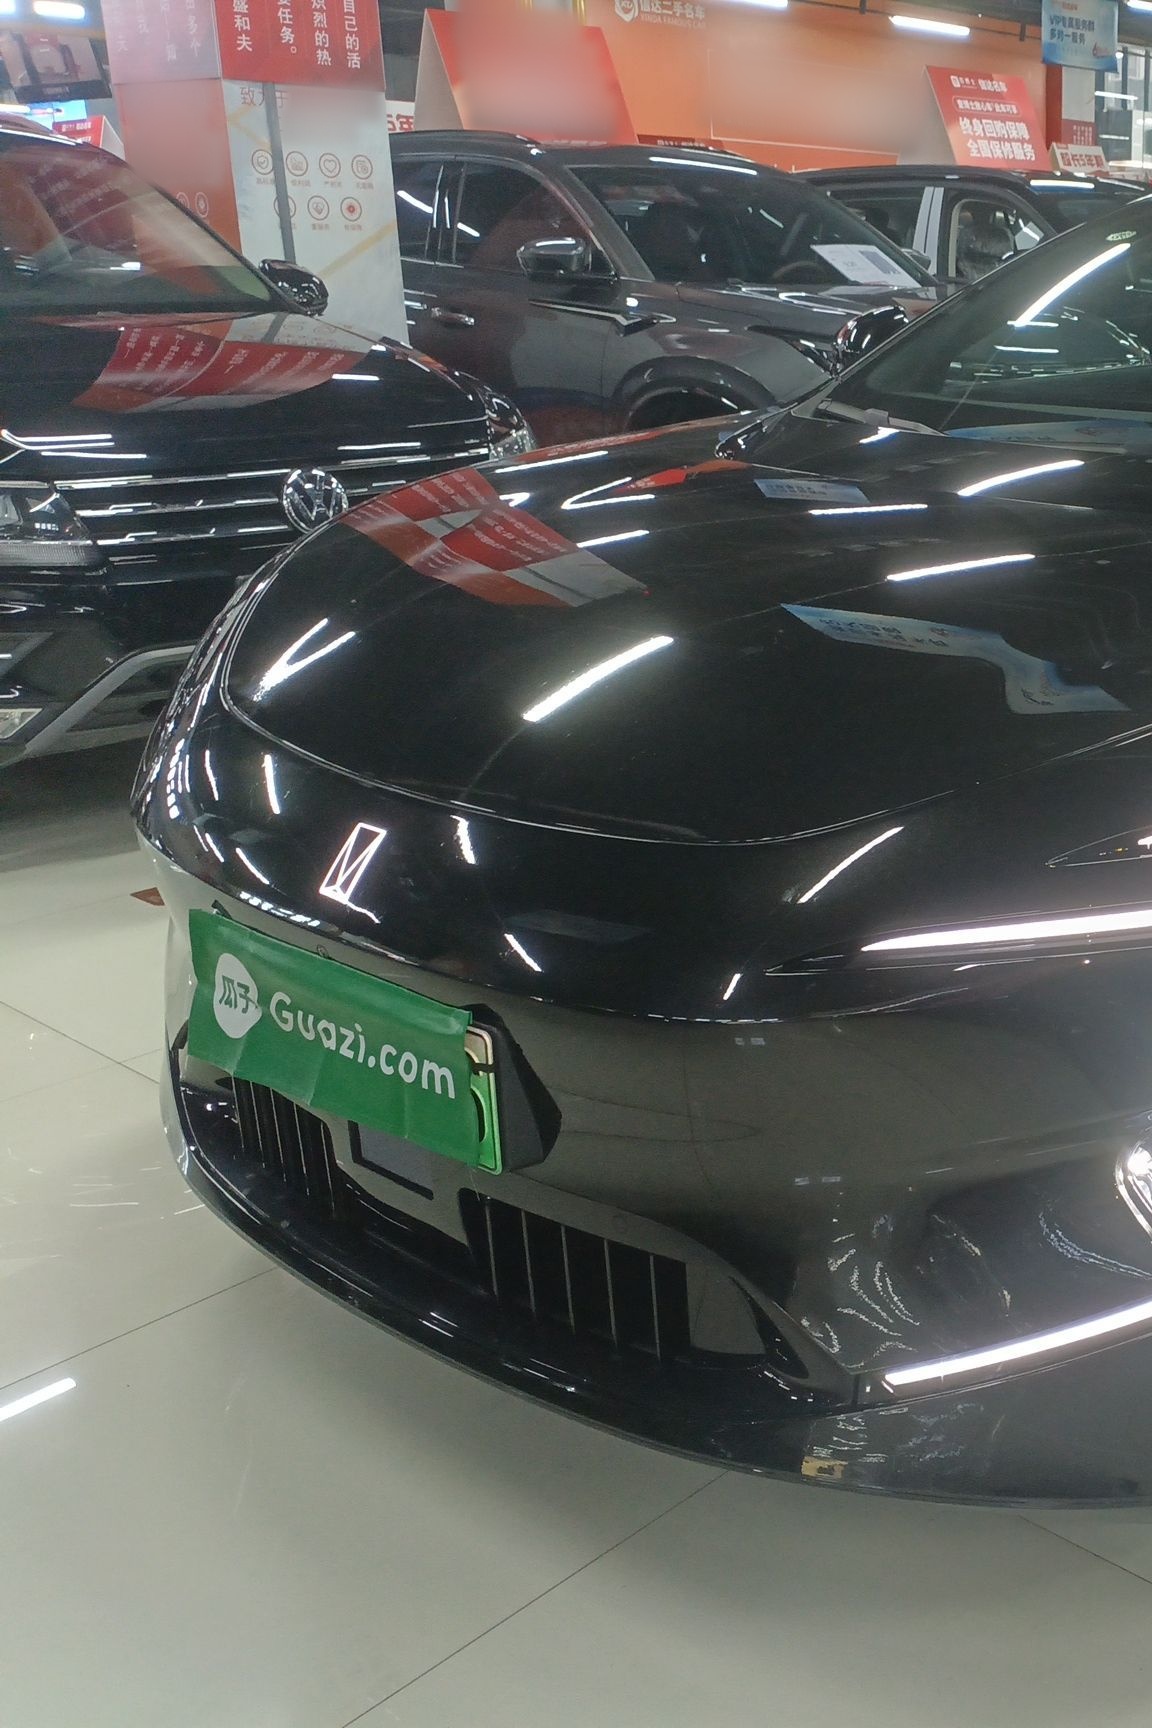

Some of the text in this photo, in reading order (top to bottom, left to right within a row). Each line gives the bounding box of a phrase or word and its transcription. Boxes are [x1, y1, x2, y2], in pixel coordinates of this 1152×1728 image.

[233, 0, 253, 52] 盛和夫
[343, 0, 361, 69] 自己的活
[959, 116, 1030, 141] 终身回购保障
[966, 138, 1037, 161] 全国保修服务
[217, 974, 260, 1015] 瓜子
[270, 991, 456, 1099] Guazi.com
